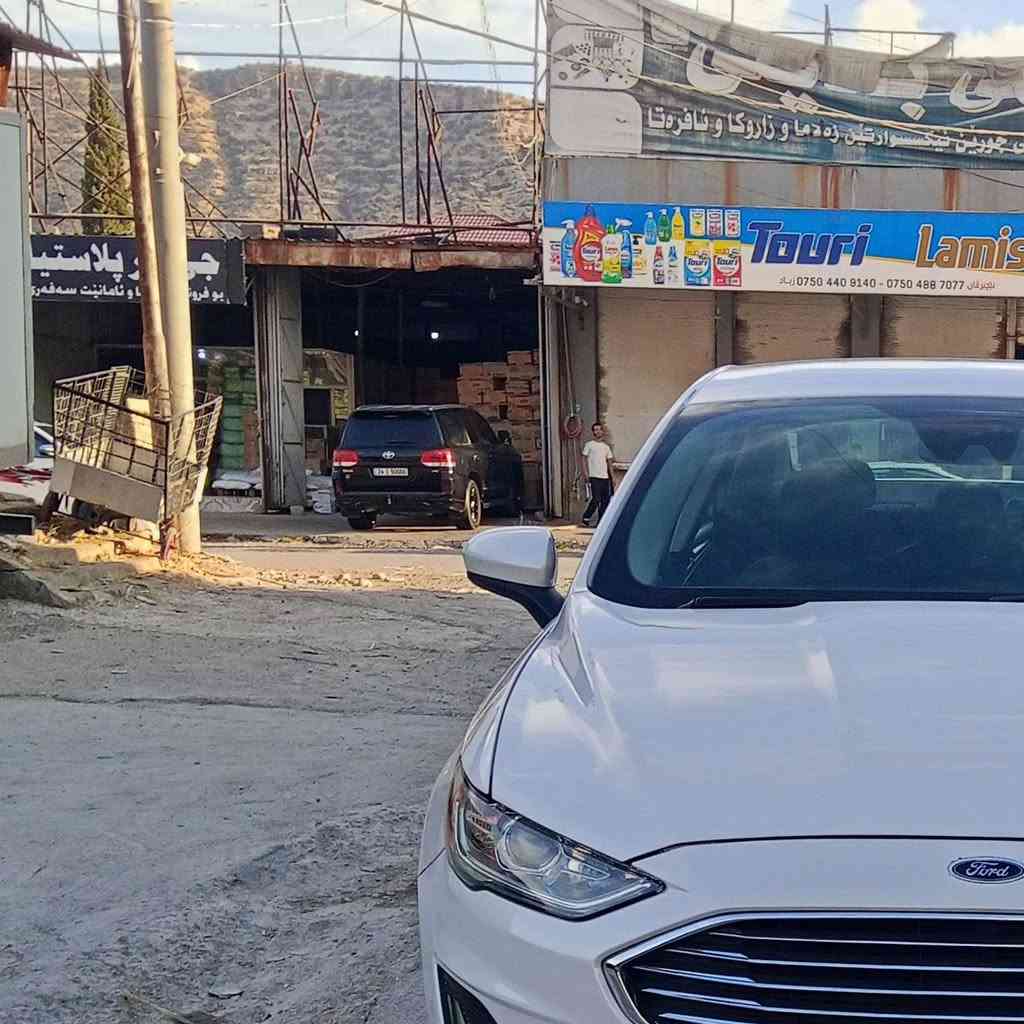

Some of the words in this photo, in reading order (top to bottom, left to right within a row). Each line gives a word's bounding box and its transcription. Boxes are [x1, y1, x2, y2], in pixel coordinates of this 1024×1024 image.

[748, 221, 873, 266] Touri
[31, 242, 124, 283] پلاستی
[796, 276, 823, 287] 0750
[826, 277, 847, 287] 440
[886, 278, 913, 289] 0750
[916, 279, 936, 290] 488
[940, 280, 965, 290] 7077
[966, 862, 1010, 876] Ford
